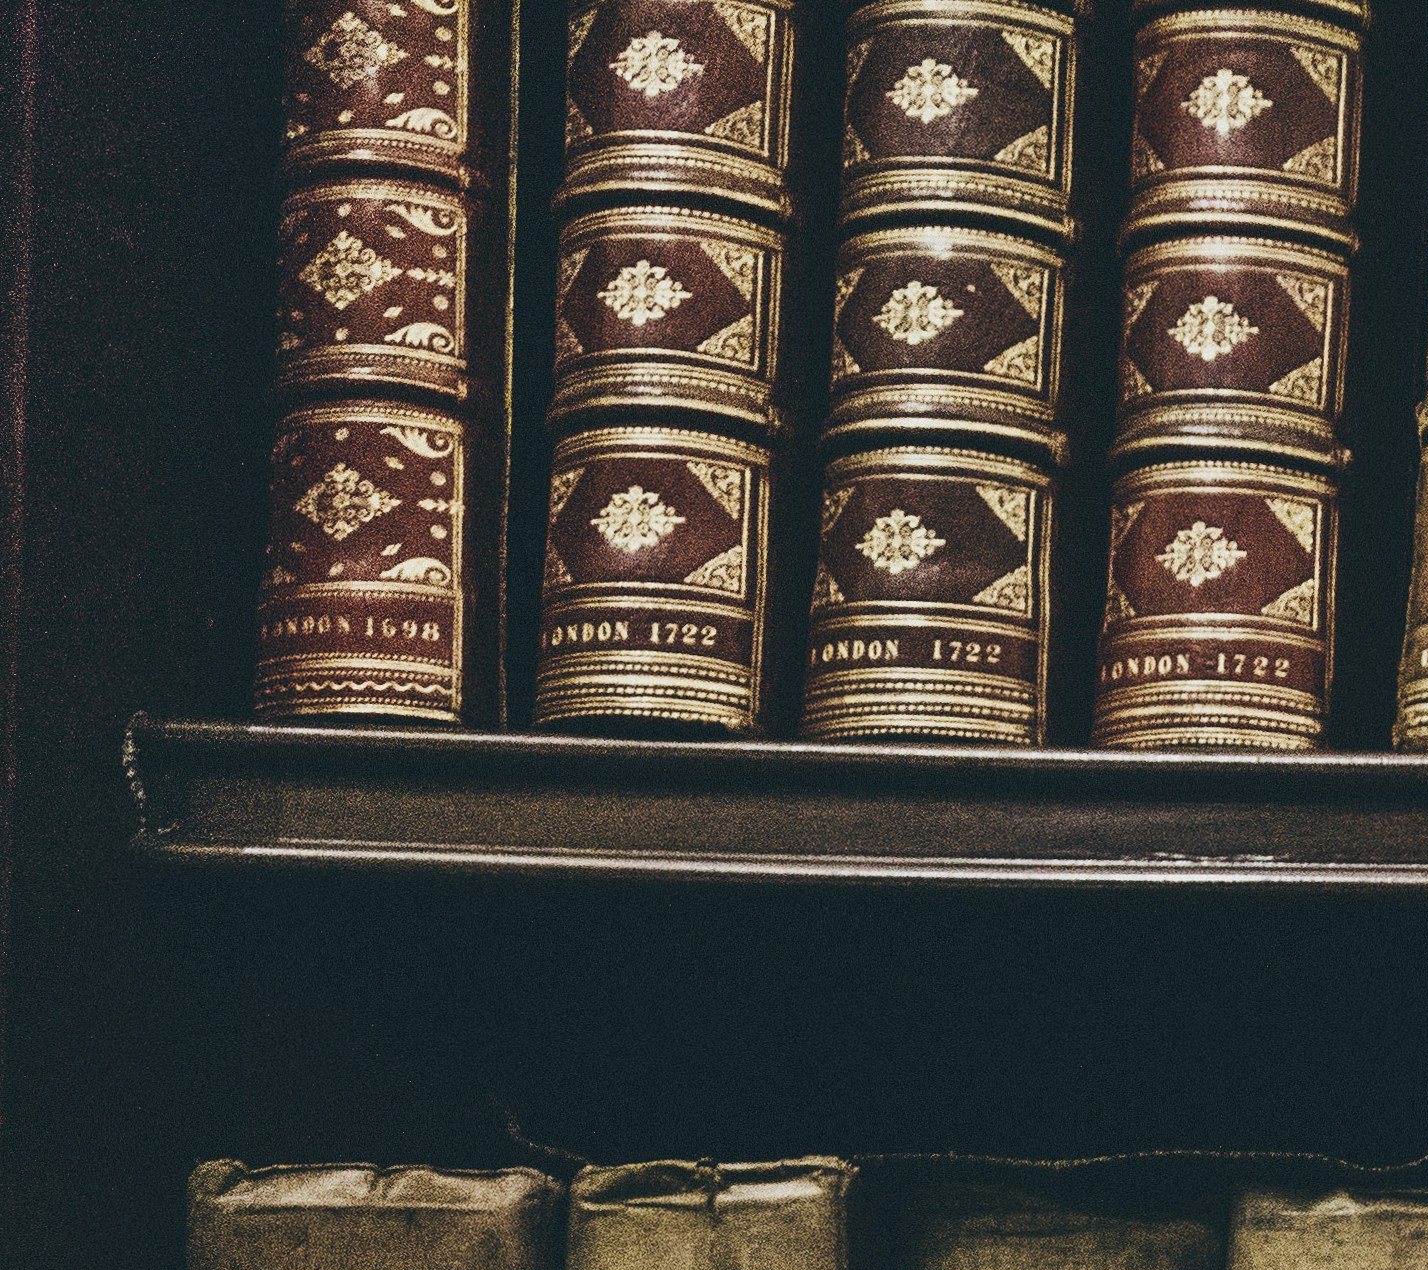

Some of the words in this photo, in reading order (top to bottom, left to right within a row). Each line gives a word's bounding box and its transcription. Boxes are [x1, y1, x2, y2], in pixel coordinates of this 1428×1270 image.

[365, 615, 440, 641] 1698
[649, 622, 717, 646] 1722
[932, 640, 1002, 664] 1722
[1217, 653, 1290, 678] 1722
